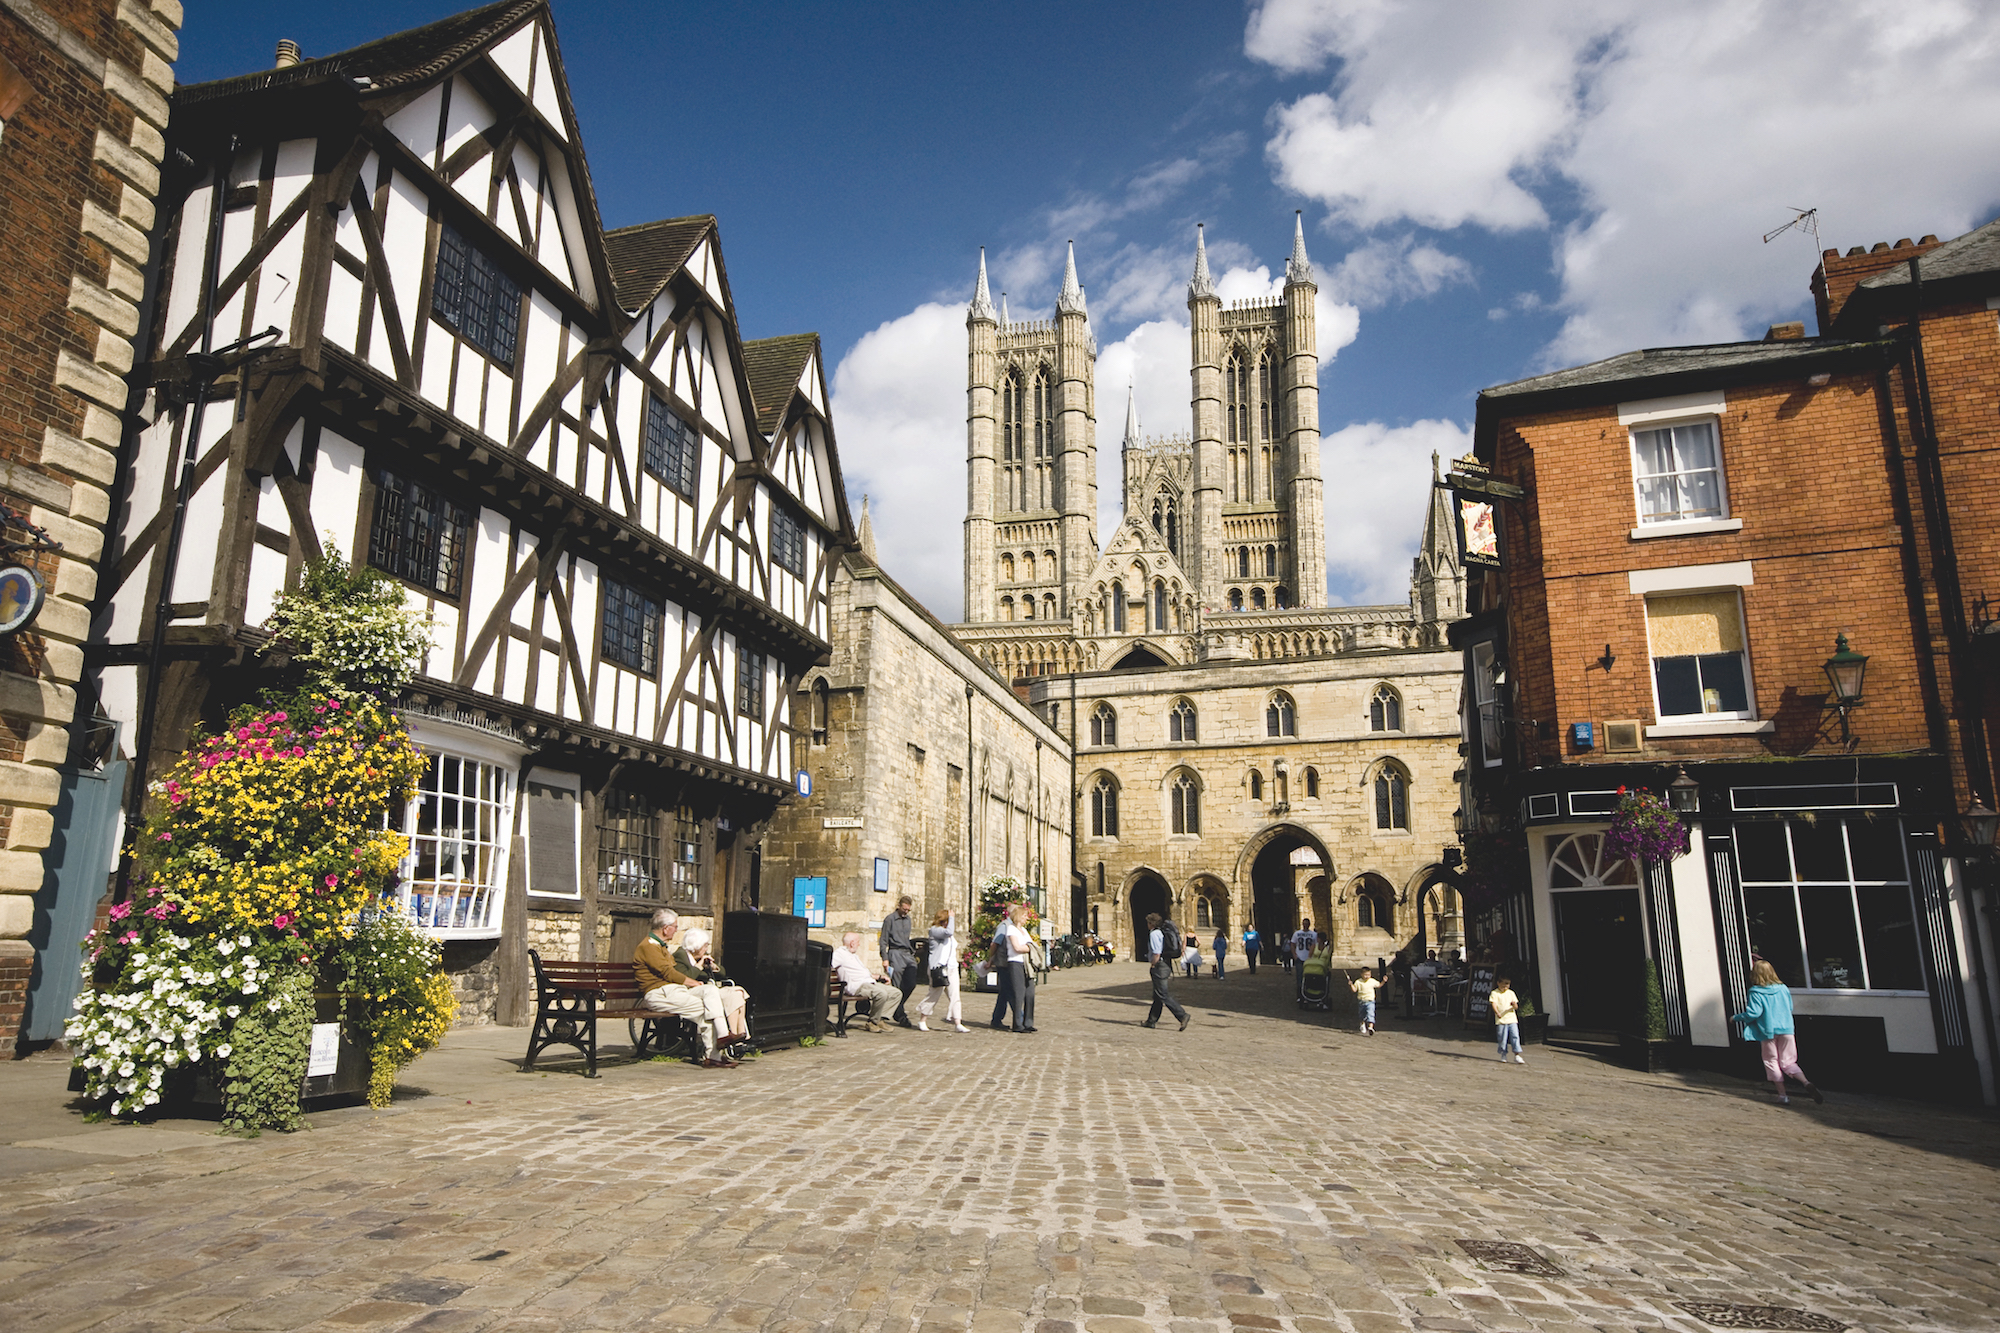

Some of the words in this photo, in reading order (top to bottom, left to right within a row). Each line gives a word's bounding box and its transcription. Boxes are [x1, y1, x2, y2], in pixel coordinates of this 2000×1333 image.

[1453, 461, 1490, 474] MARSTON'S
[1465, 555, 1484, 564] MAGNA
[1484, 559, 1501, 567] CARTA
